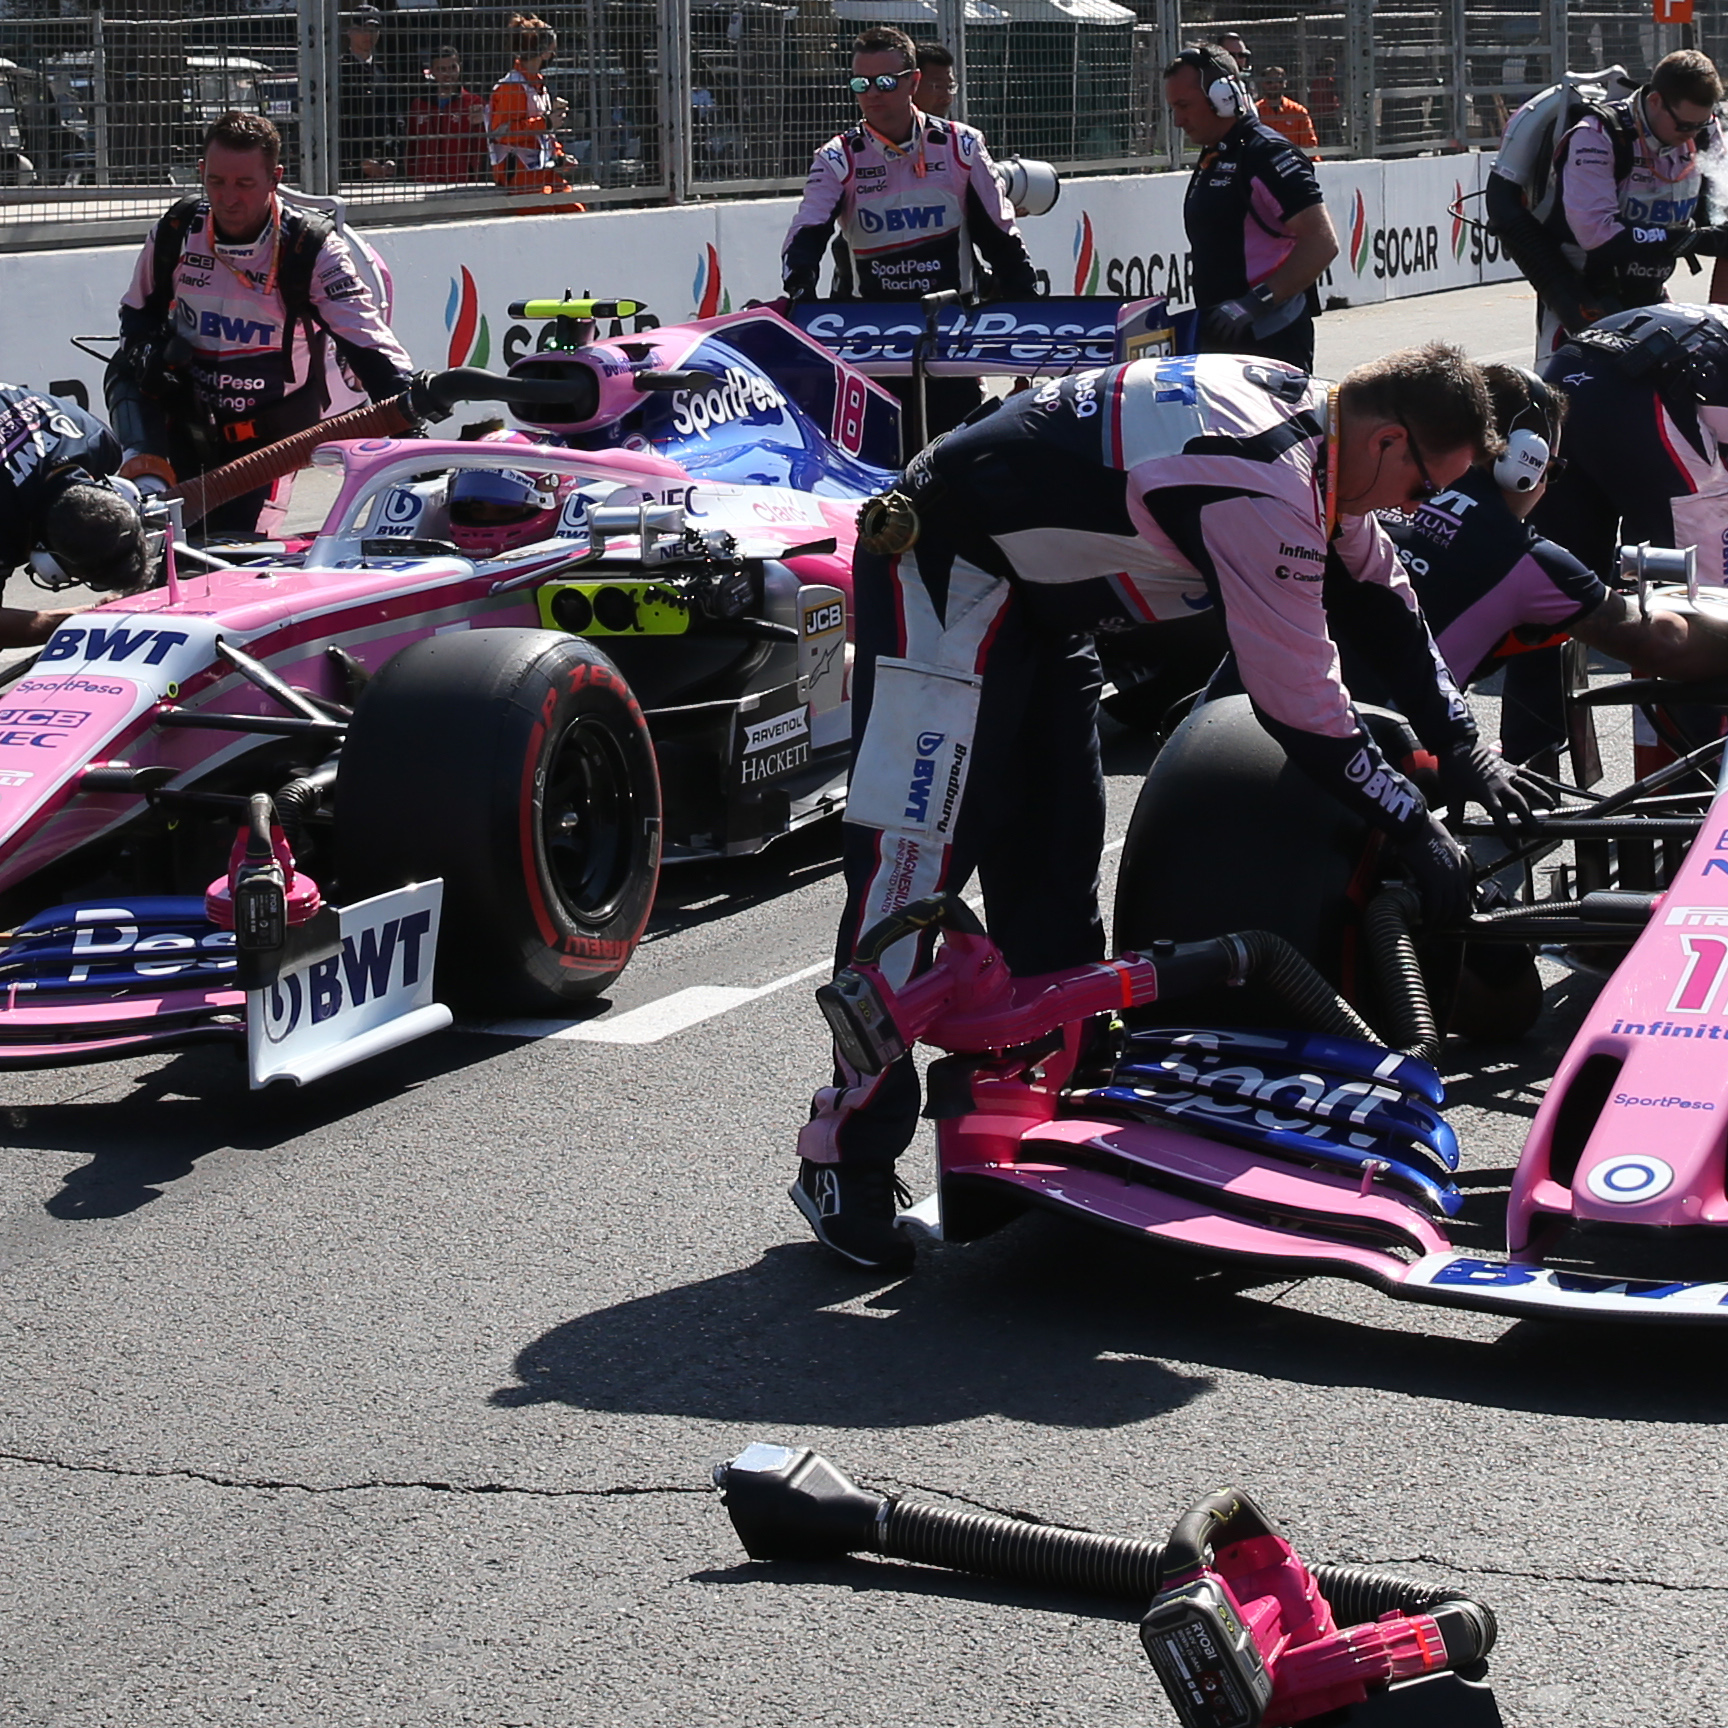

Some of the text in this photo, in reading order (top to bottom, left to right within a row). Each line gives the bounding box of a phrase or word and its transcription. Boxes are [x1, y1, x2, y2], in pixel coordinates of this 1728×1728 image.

[856, 182, 883, 194] Claro
[857, 166, 886, 179] JCB
[884, 205, 947, 232] BWT
[871, 259, 942, 279] SportPesa
[1373, 225, 1438, 279] SOCAR
[881, 277, 931, 292] Racing
[200, 309, 276, 345] BWT
[672, 366, 787, 442] SportPesa
[831, 359, 867, 458] 18
[752, 502, 806, 523] Claro
[376, 525, 415, 536] BWT
[806, 602, 843, 635] JCB
[40, 628, 190, 666] BWT
[15, 679, 123, 704] SportPesa
[752, 716, 803, 744] RAVENOL
[741, 741, 810, 784] HACKETT
[903, 759, 936, 823] BWT
[937, 742, 969, 834] Bradbury
[1361, 774, 1415, 823] BWT
[1427, 837, 1455, 870] HyFlex
[308, 909, 431, 1026] BWT
[1160, 1033, 1402, 1146] Sport
[1613, 1093, 1716, 1111] SportPesa
[1190, 1621, 1218, 1660] RYOBI
